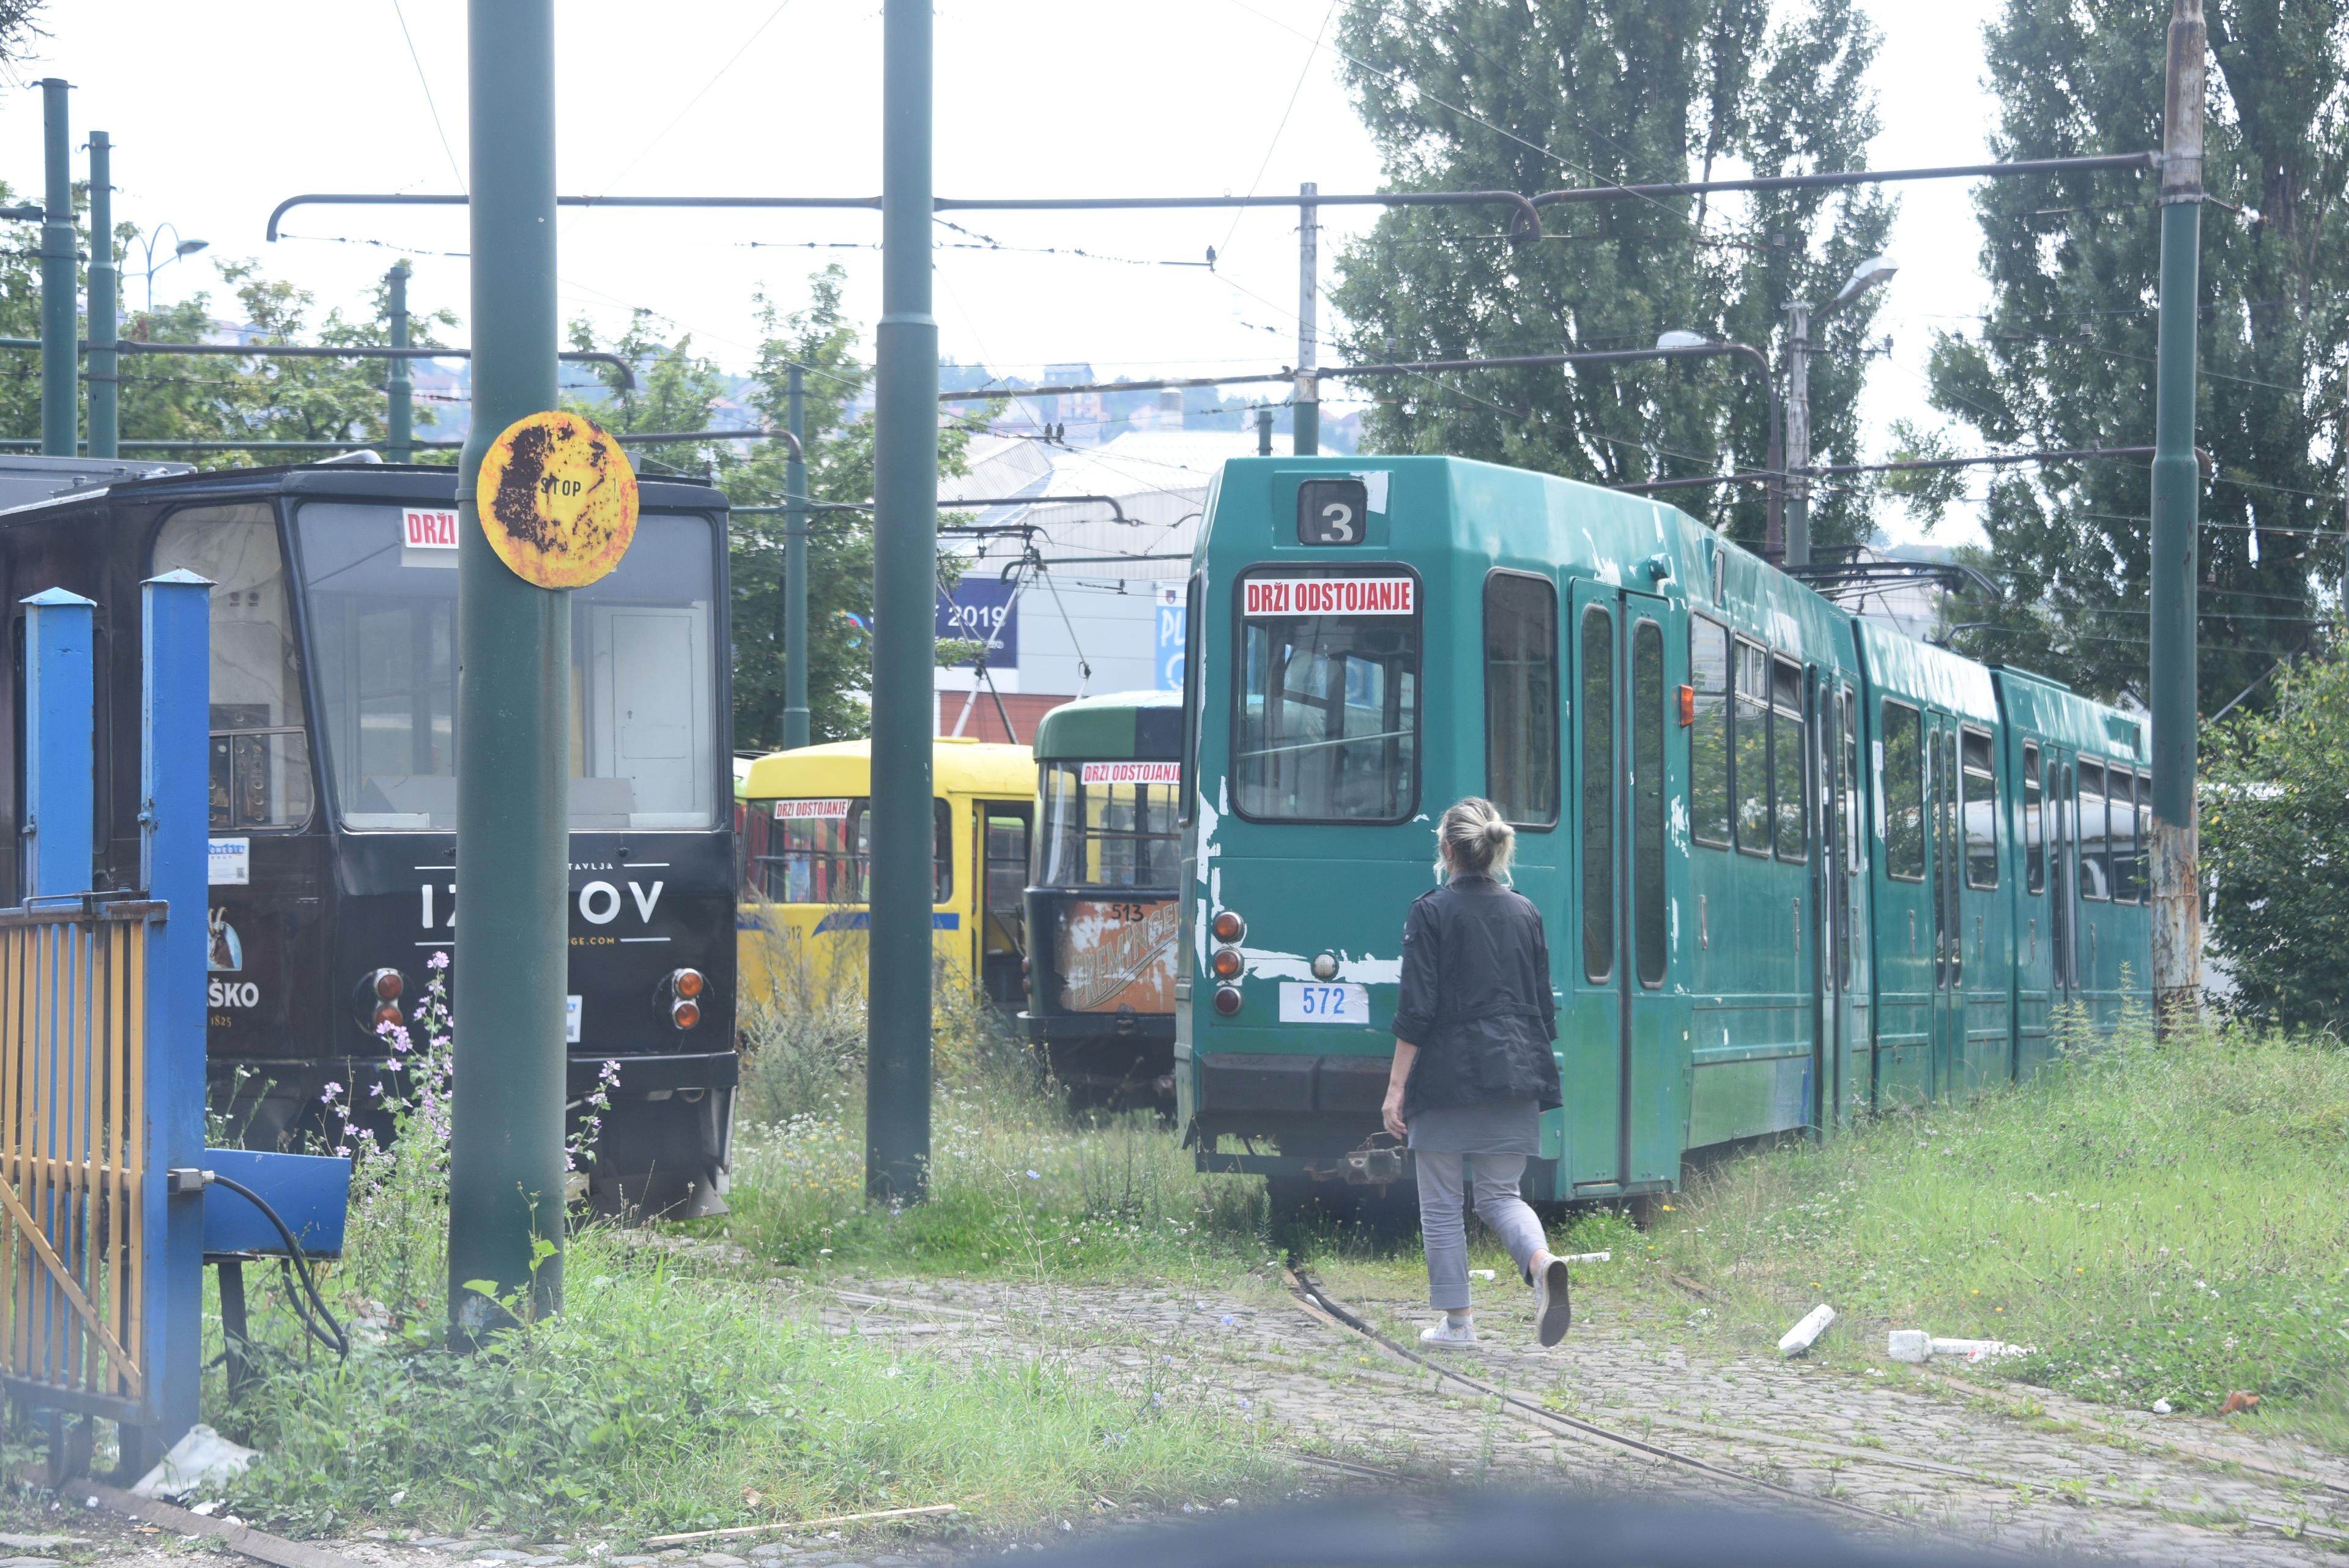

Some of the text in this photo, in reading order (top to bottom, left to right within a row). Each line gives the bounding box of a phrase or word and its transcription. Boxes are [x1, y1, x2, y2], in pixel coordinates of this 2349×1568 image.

[541, 477, 581, 497] STOP
[407, 513, 456, 544] DRŽI
[1321, 503, 1353, 541] 3
[1248, 582, 1410, 612] DRŽI ODSTOJANJE
[948, 605, 1007, 627] 2019
[1161, 609, 1186, 647] PL
[1085, 765, 1110, 782] DRŽI
[777, 801, 847, 817] DRŽI ODSTOJANJE
[1111, 904, 1144, 922] 513
[568, 937, 615, 945] GE.COM
[207, 978, 259, 1008] ŠKO
[1303, 987, 1345, 1014] 572
[211, 1015, 232, 1028] 1825
